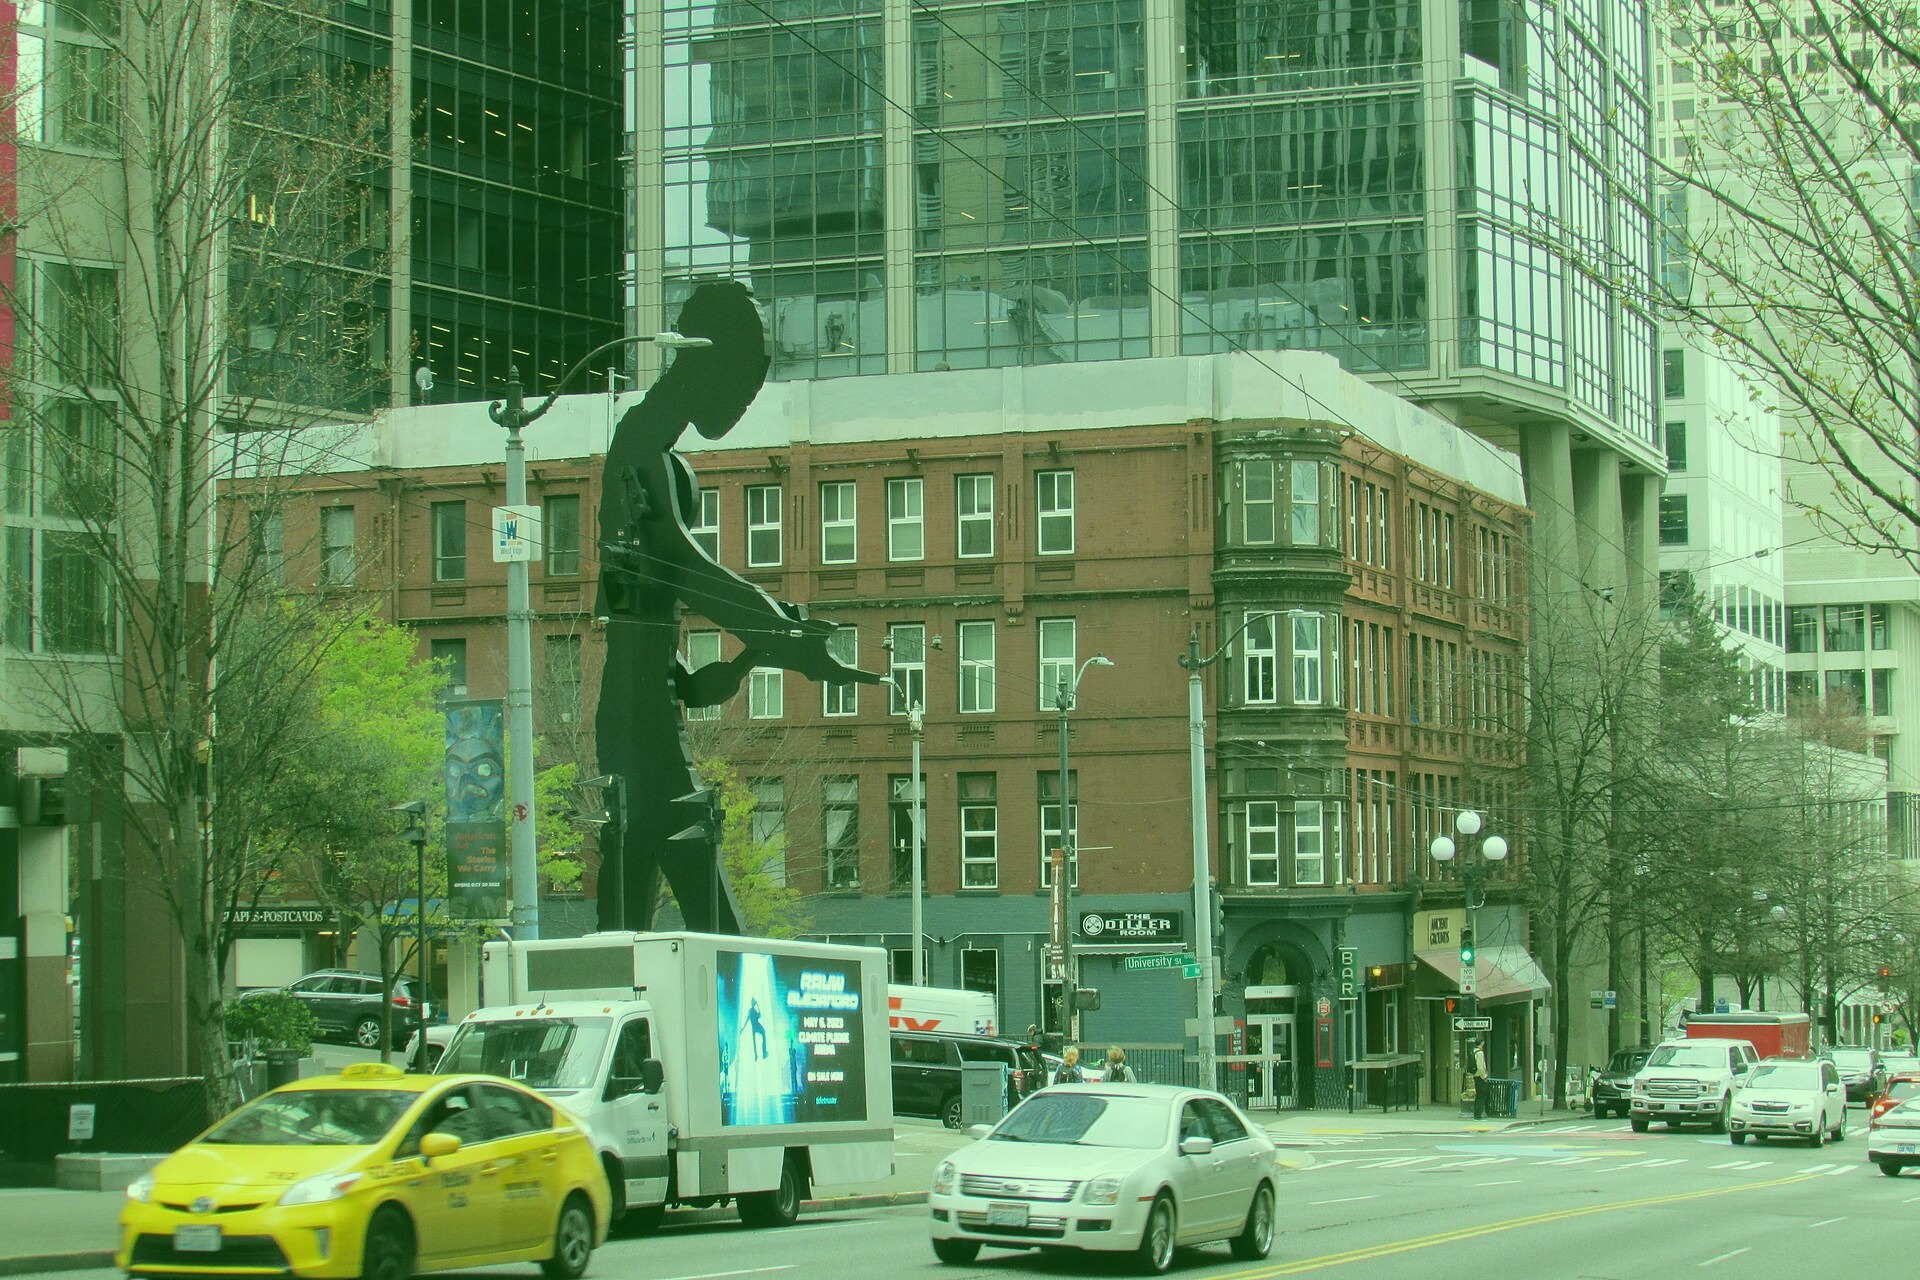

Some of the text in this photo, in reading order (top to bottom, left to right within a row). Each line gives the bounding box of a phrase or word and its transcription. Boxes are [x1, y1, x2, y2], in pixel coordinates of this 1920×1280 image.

[506, 520, 518, 540] W
[466, 856, 496, 864] Stories
[473, 865, 497, 873] Carry
[263, 910, 323, 922] POSTCARDS
[1105, 919, 1171, 930] DILLER
[1128, 957, 1173, 969] University
[1342, 951, 1354, 995] BAR
